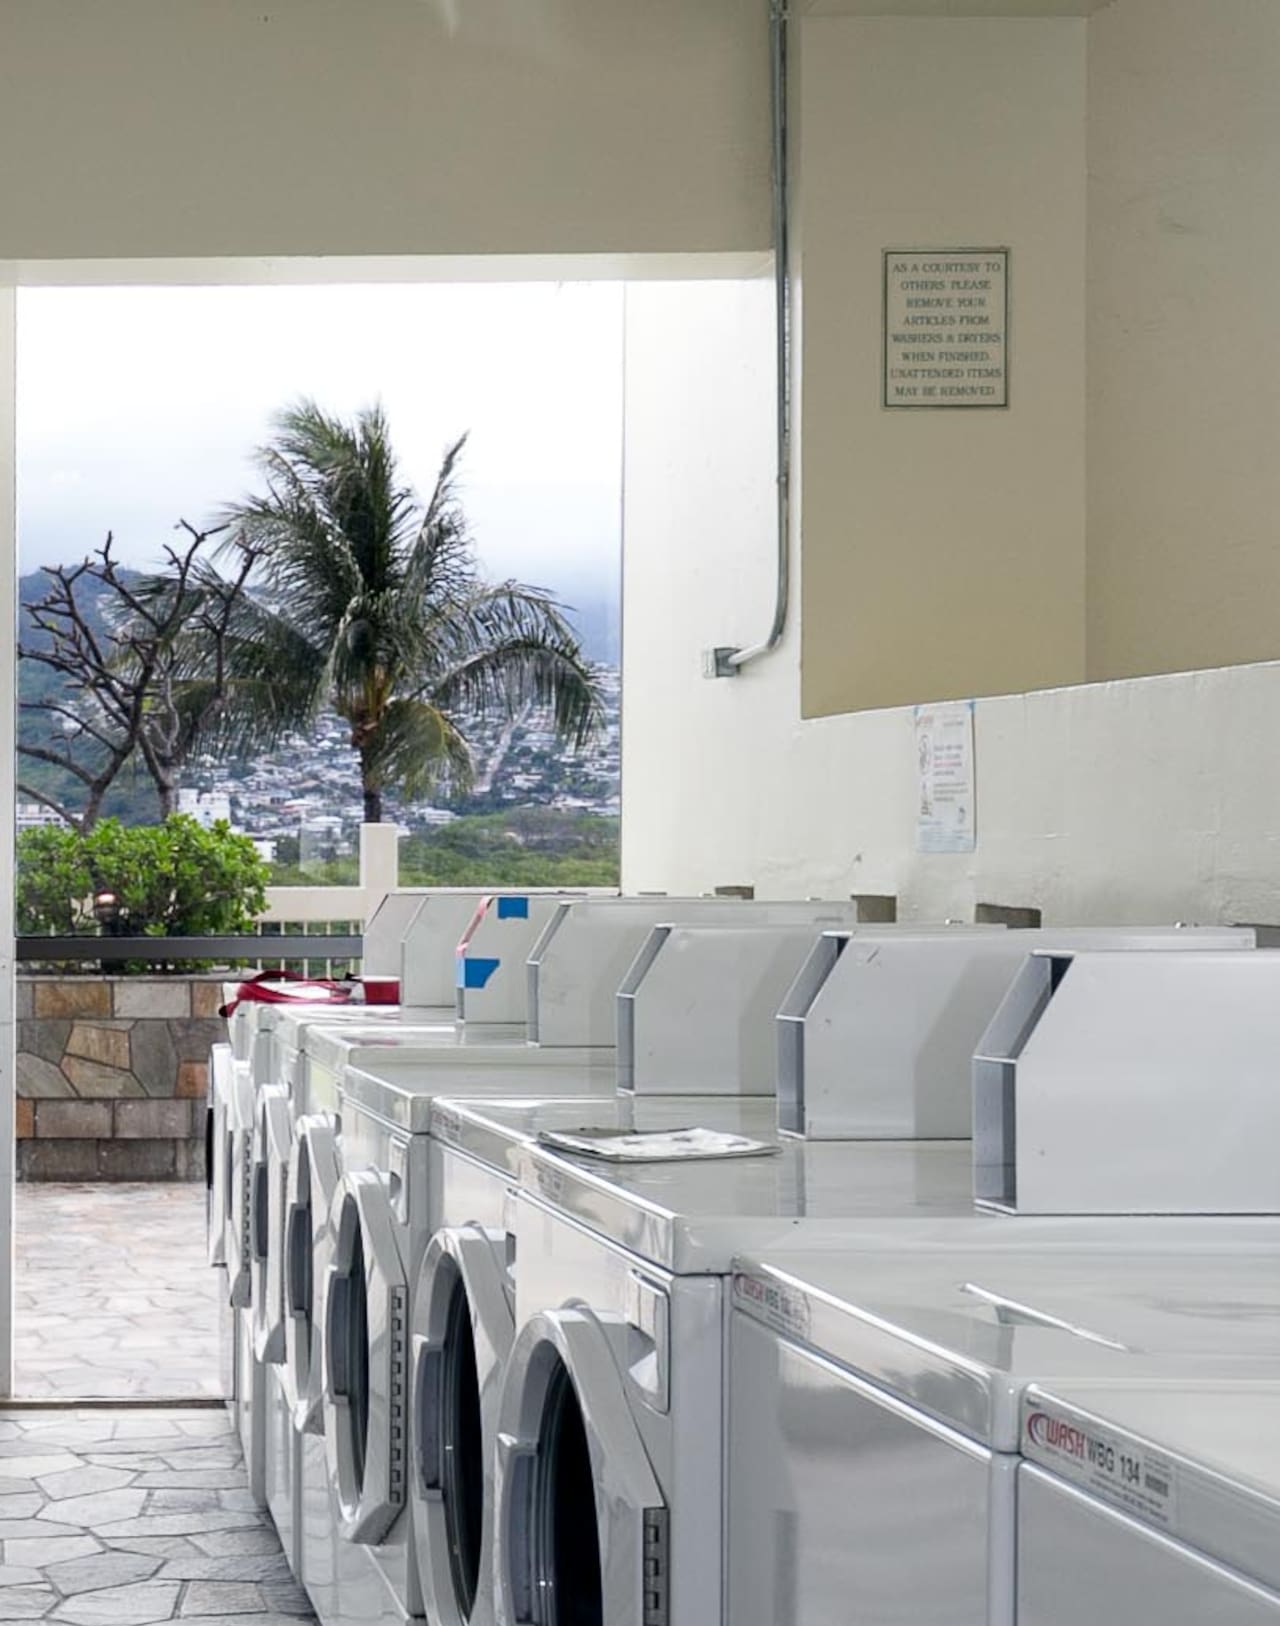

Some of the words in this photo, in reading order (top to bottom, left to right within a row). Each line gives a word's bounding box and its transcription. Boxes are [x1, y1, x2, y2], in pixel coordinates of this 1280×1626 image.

[892, 263, 907, 273] AS
[910, 263, 920, 273] A
[922, 263, 981, 273] COURTESY
[984, 263, 1001, 273] TO
[900, 280, 945, 290] OTHERS
[950, 280, 991, 290] PLEASE
[906, 298, 953, 308] REMOVE
[957, 298, 986, 308] YOUR
[903, 316, 956, 326] ARTICLES
[959, 316, 990, 326] FROM
[891, 334, 943, 343] WASHERS
[957, 334, 1001, 343] DRYERS
[901, 351, 935, 361] WHEN
[967, 369, 1002, 378] ITEMS
[895, 386, 918, 396] MAY
[922, 386, 937, 396] BE
[1046, 1418, 1086, 1460] WASH
[1120, 1455, 1140, 1486] 134
